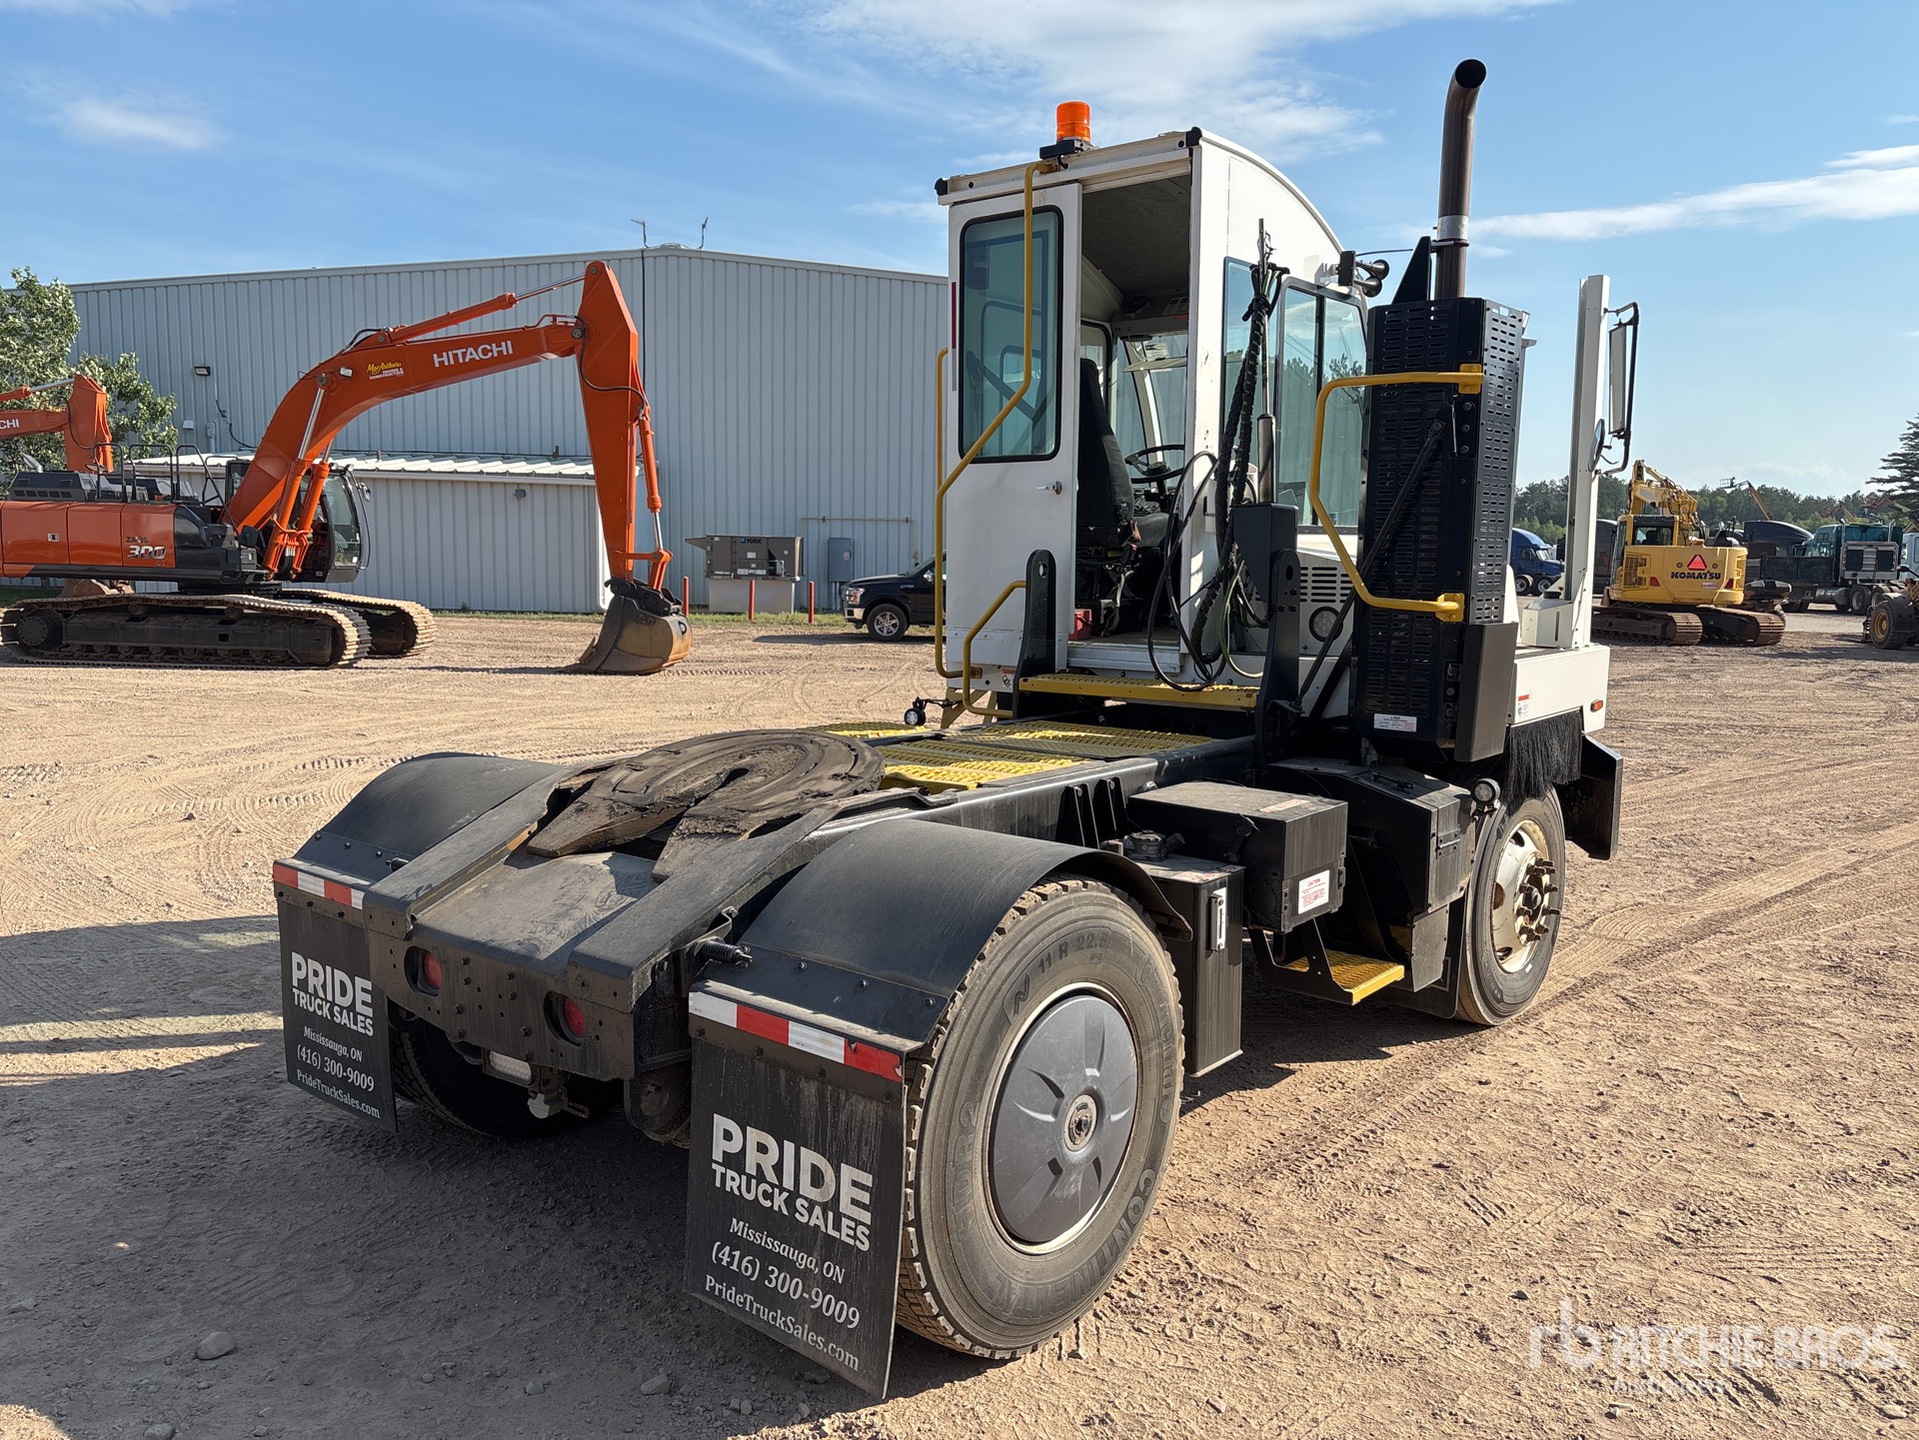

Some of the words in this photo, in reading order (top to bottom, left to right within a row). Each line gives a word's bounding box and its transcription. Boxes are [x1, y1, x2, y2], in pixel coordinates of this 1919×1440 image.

[433, 340, 513, 368] HITACHI
[127, 544, 167, 560] 300
[1670, 570, 1722, 580] KOMATSU
[1058, 941, 1069, 960] R
[291, 951, 374, 1018] PRIDE
[292, 987, 332, 1020] TRUCK
[333, 1007, 374, 1037] SALES
[297, 1043, 322, 1070] (416)
[324, 1056, 375, 1092] 300-9009
[303, 1025, 350, 1058] Mississauga,
[350, 1047, 363, 1063] ON
[296, 1069, 380, 1119] PrideTruckSales.com
[711, 1112, 873, 1226] PRIDE
[711, 1162, 790, 1217] TRUCK
[794, 1197, 871, 1252] SALES
[729, 1217, 819, 1275] Mississauga,
[822, 1260, 846, 1285] ON
[711, 1241, 761, 1282] (416)
[764, 1265, 860, 1330] 300-9009
[705, 1274, 860, 1372] PrideTruckSales.com
